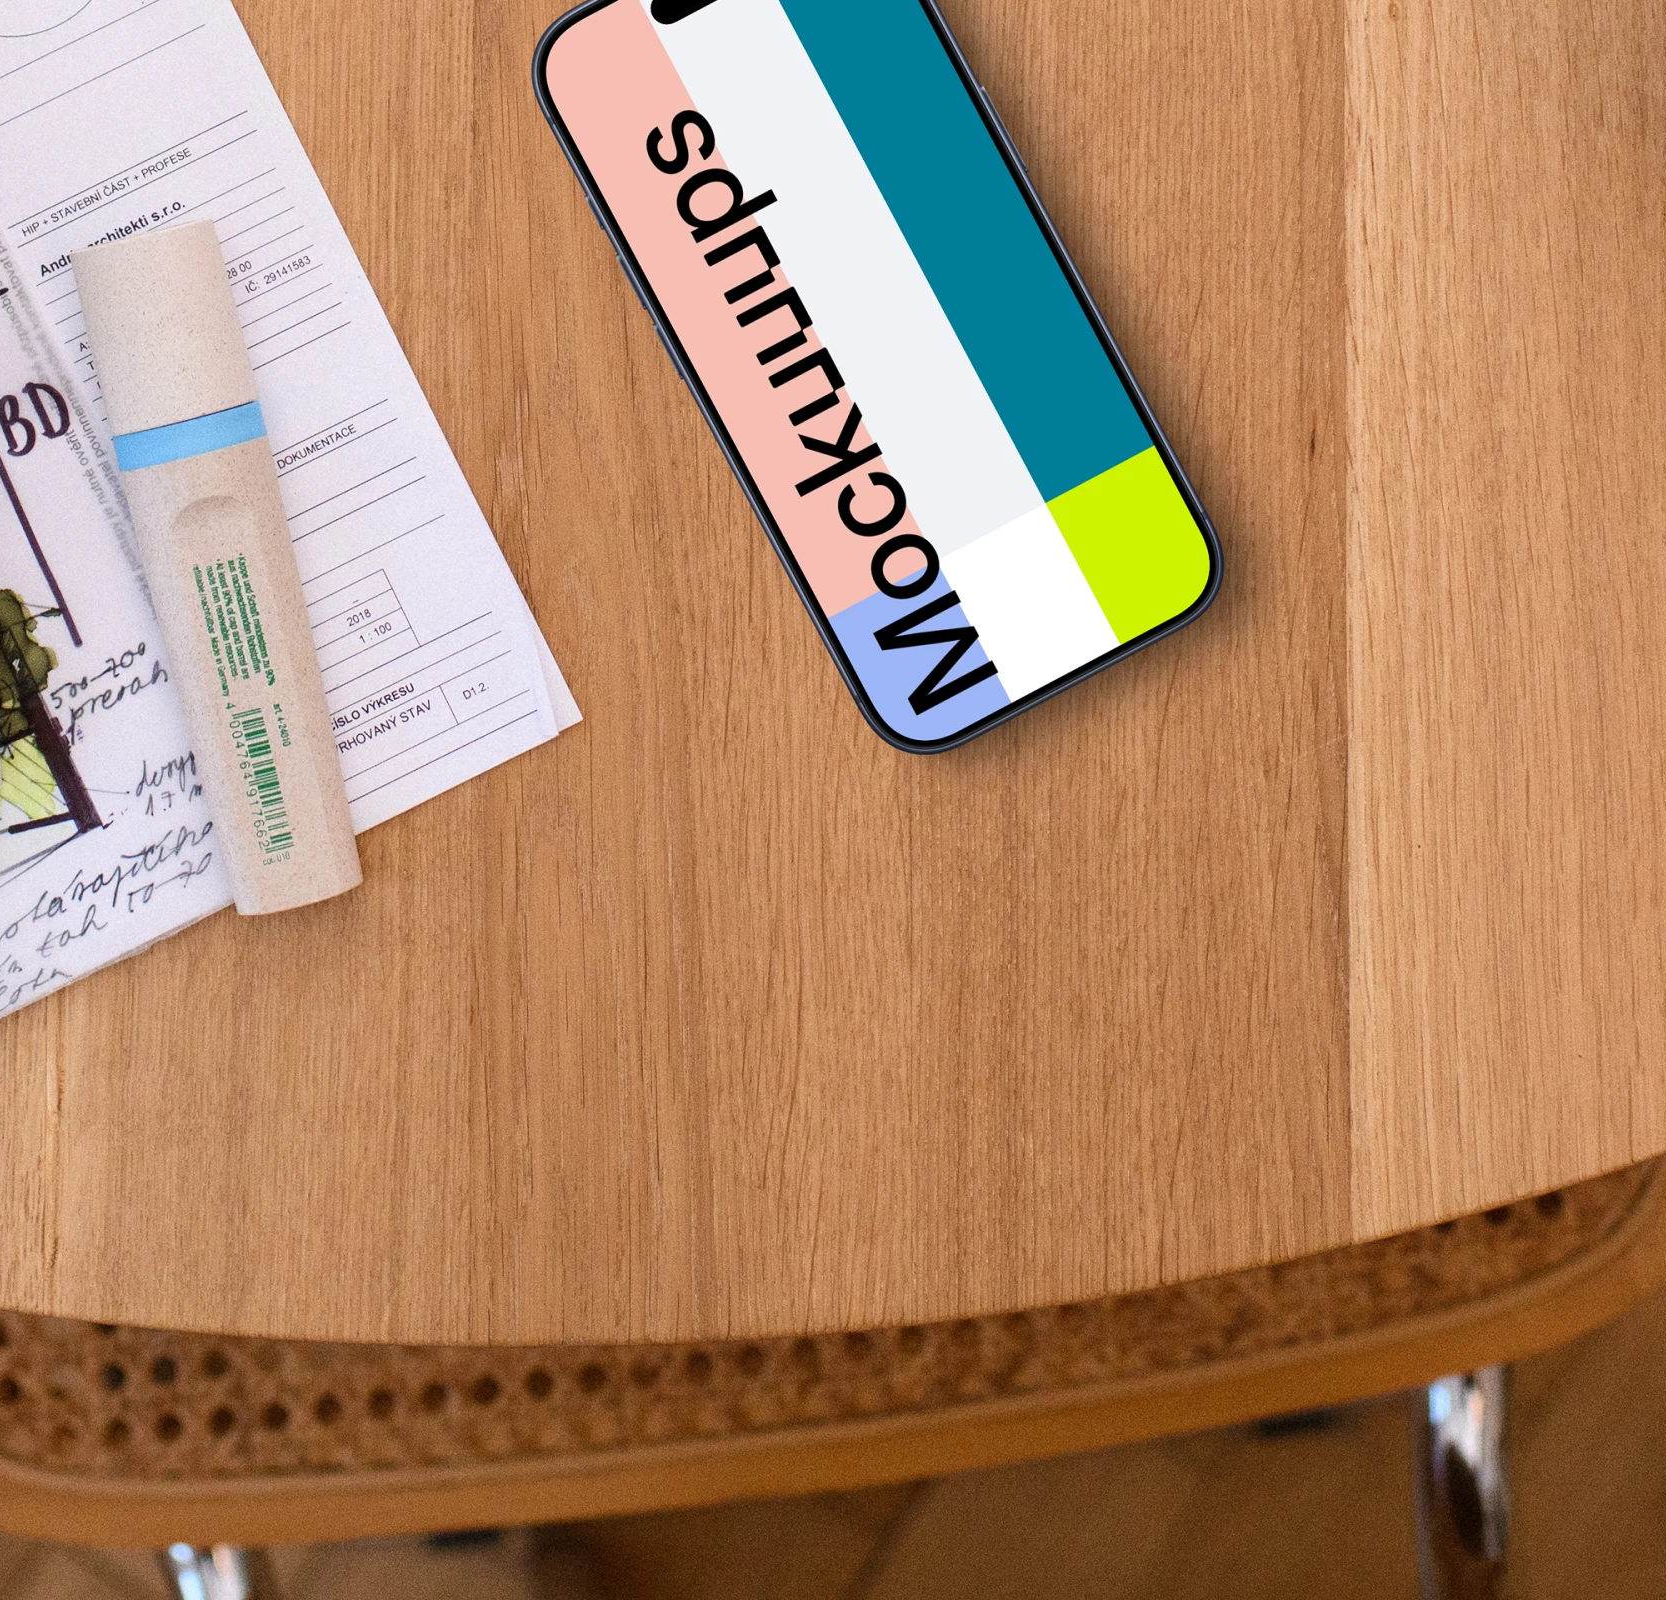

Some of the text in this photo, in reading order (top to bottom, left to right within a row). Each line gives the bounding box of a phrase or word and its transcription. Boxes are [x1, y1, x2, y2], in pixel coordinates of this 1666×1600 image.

[21, 147, 192, 237] HIP STAVEBNÍ ČÁST PROFESE
[151, 202, 185, 222] s.r.o.
[226, 260, 252, 280] 28 00
[263, 255, 311, 285] 29141583
[276, 424, 356, 470] DOKUMENTACE
[222, 589, 233, 607] 90%
[235, 555, 250, 579] Kappe
[243, 579, 253, 594] und
[264, 668, 276, 686] 90%
[346, 608, 371, 627] 2018
[374, 622, 392, 636] 100
[361, 683, 415, 714] VÝKRESU
[334, 699, 431, 754] RHOVANÝ STAV
